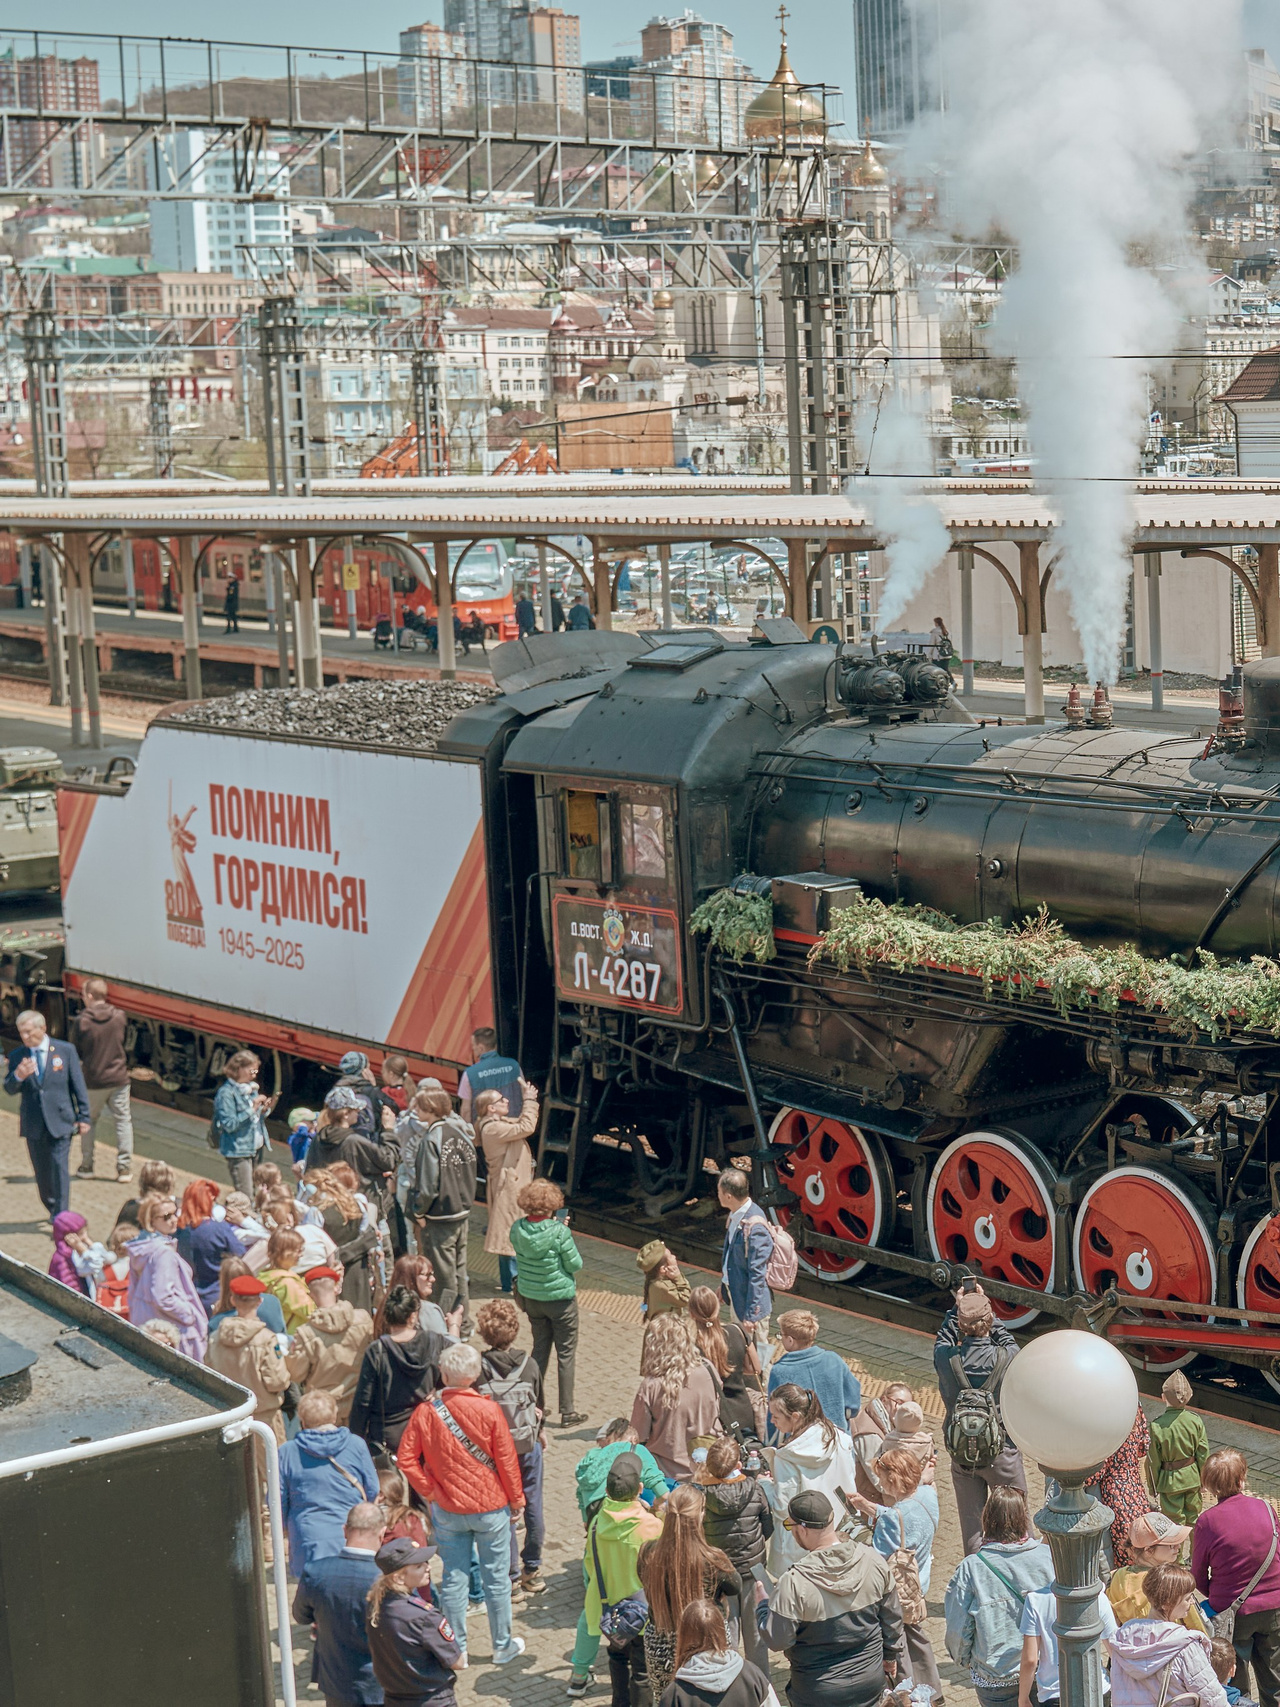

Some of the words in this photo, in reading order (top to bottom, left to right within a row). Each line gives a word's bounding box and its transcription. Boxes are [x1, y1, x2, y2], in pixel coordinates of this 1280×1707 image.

[209, 783, 340, 866] ПОМНИМ,
[165, 879, 185, 917] 80
[213, 853, 368, 934] ГОРДИМСЯ!
[571, 921, 603, 940] Д.ВОСТ.
[631, 930, 653, 948] Ж.Д.
[574, 951, 661, 1003] Л-4287
[478, 1066, 513, 1079] ВОЛОНТЕР
